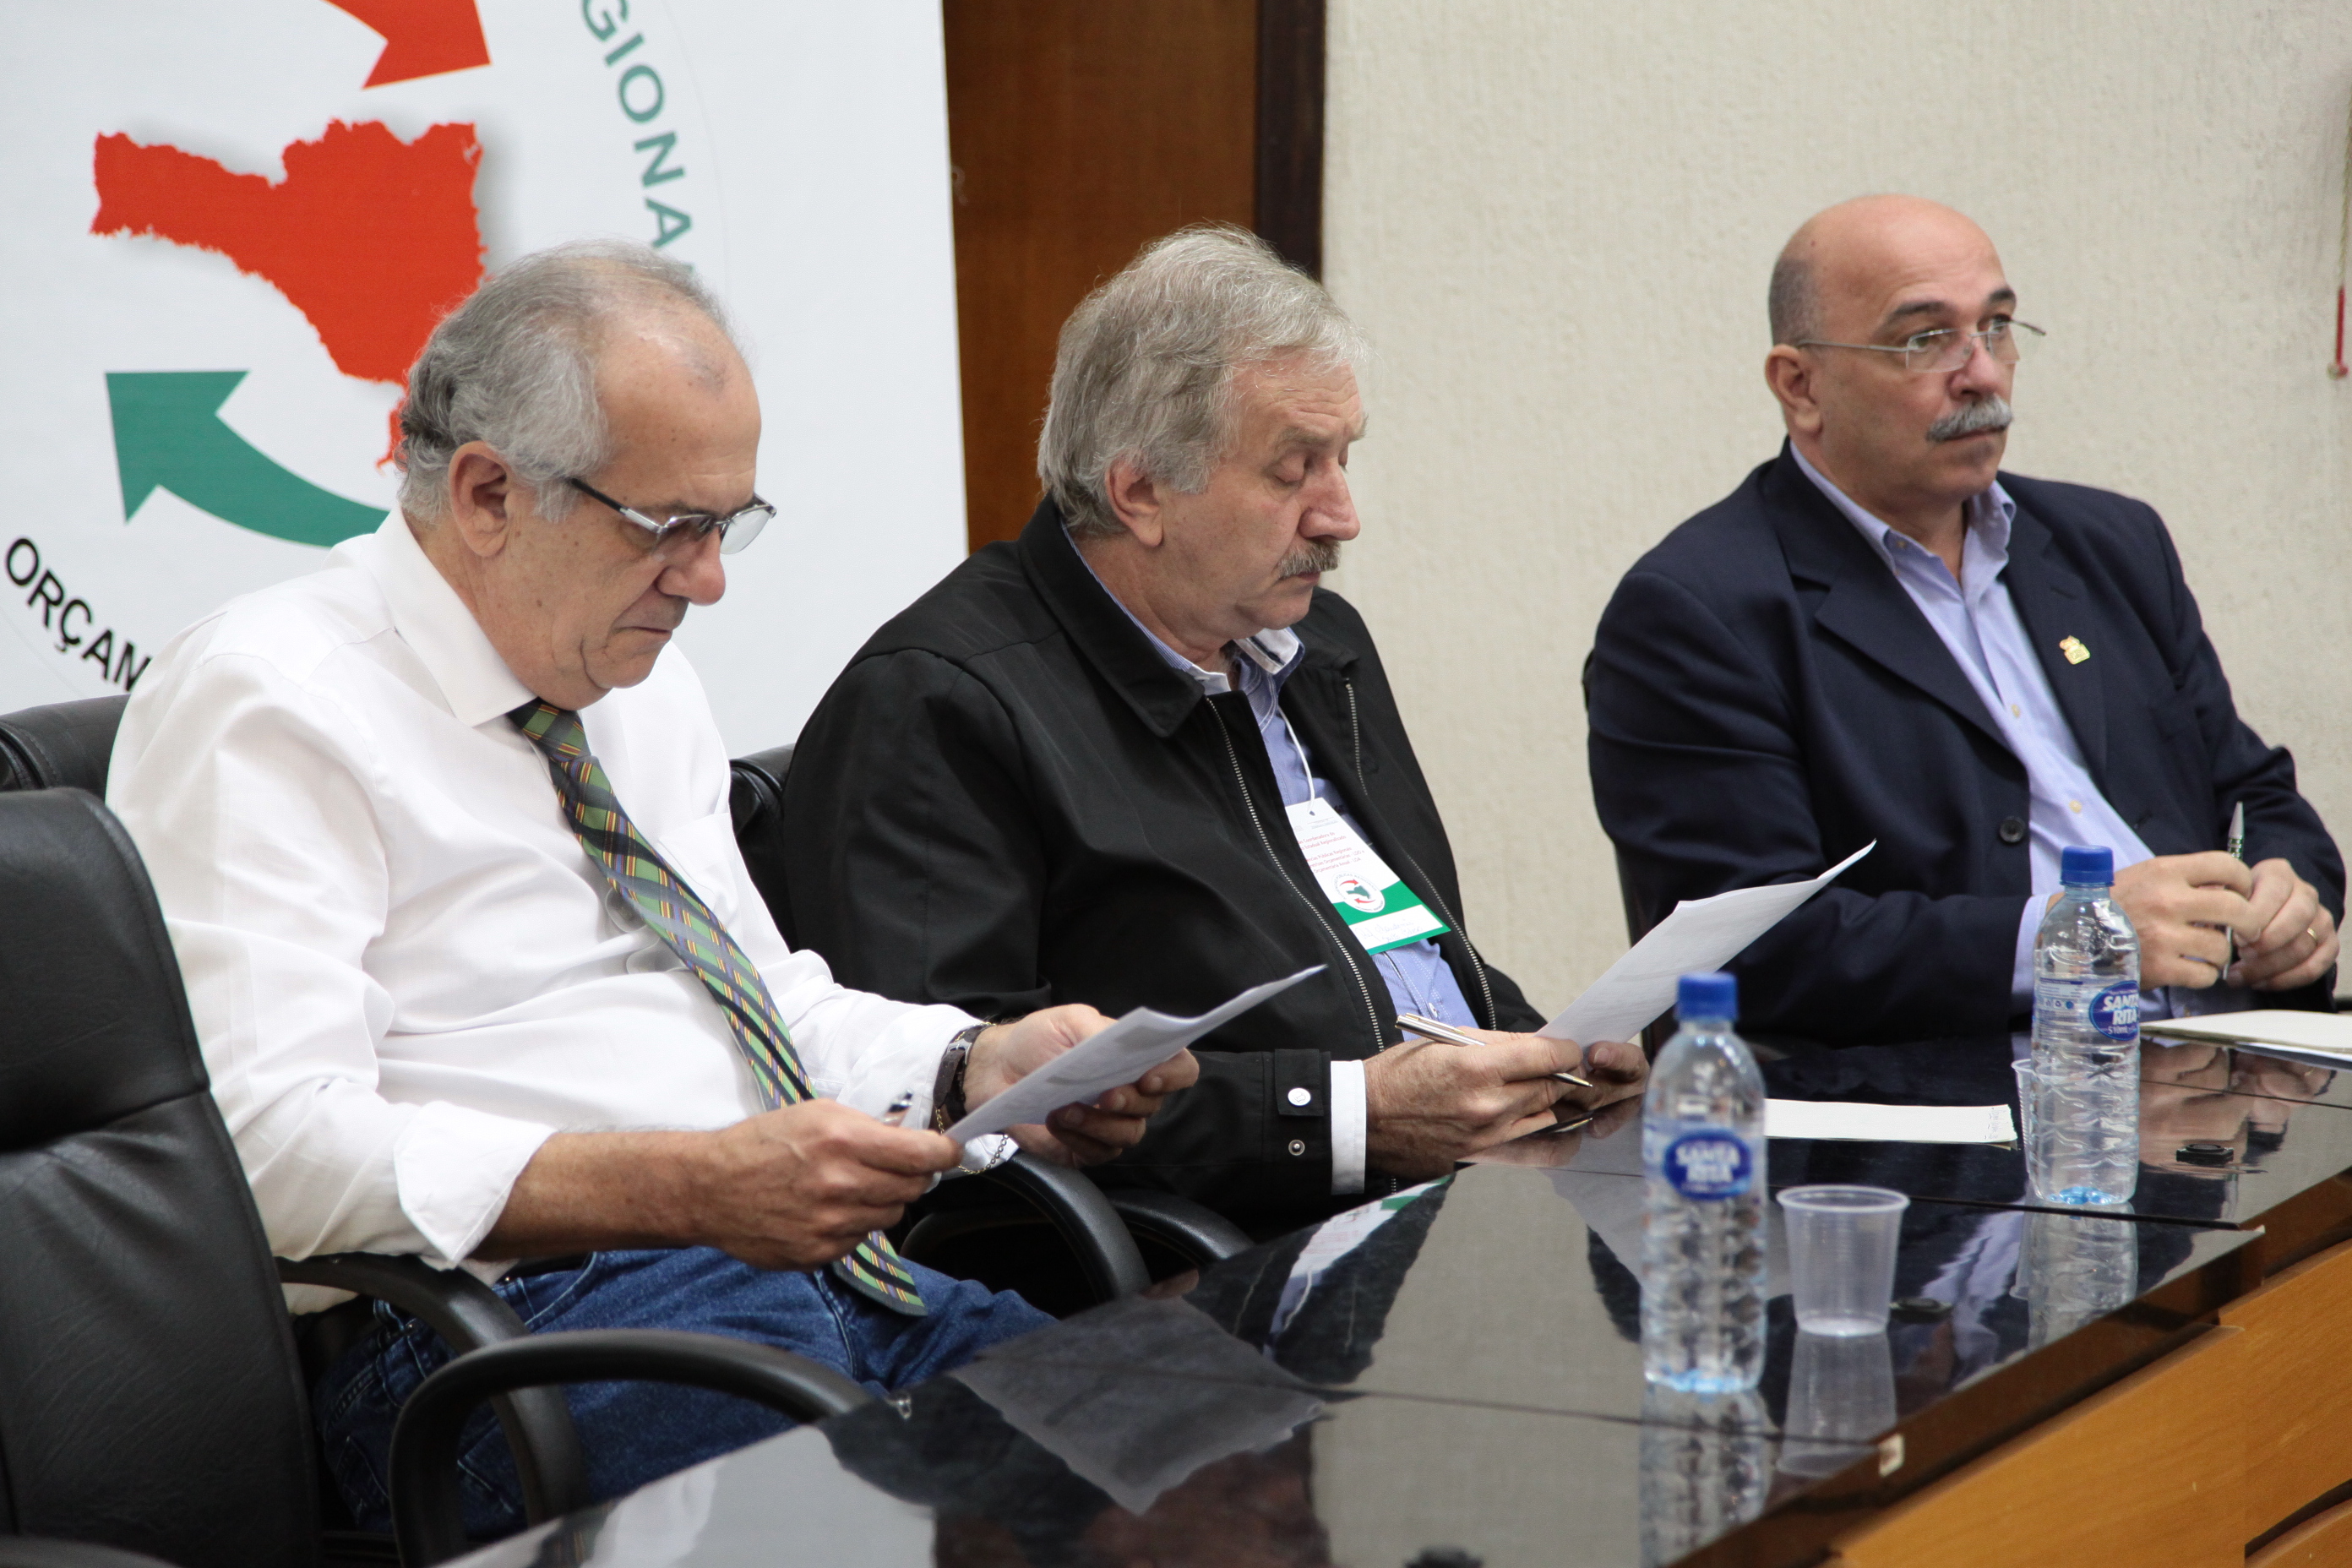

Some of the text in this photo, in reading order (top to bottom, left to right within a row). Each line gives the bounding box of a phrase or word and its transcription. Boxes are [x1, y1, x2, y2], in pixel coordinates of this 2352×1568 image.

[581, 0, 694, 275] GIONA
[6, 538, 151, 692] ORÇAN
[2113, 1009, 2137, 1025] RITA
